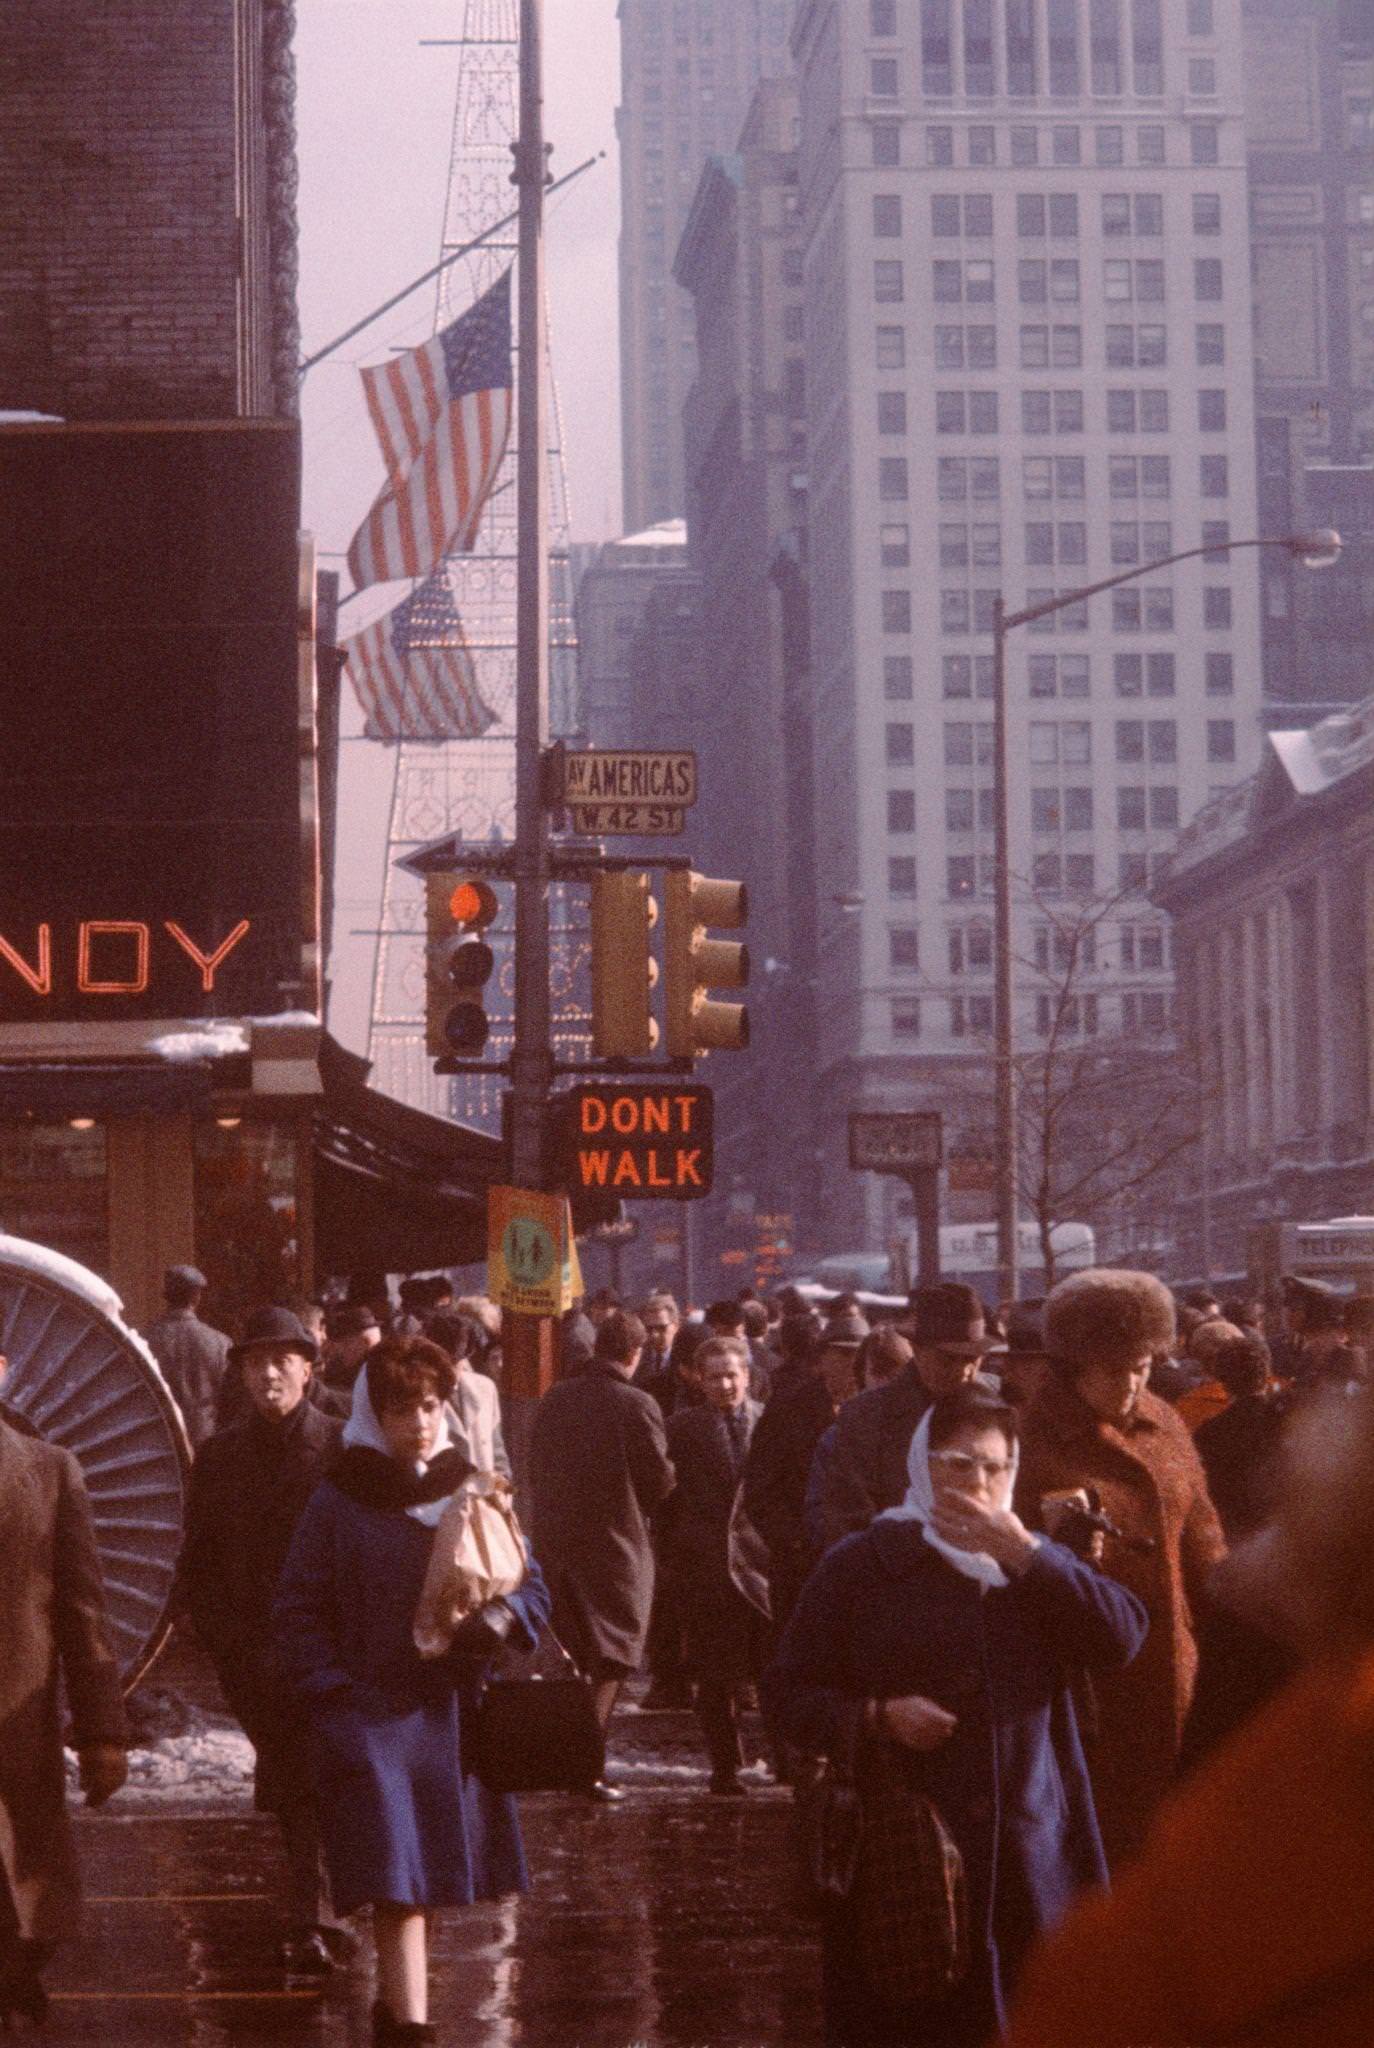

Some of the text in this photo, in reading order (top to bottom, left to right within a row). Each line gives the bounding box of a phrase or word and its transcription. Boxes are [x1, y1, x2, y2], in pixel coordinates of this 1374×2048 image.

[589, 759, 690, 796] AMERICAS
[608, 806, 640, 829] 42
[648, 806, 676, 829] ST
[580, 1096, 698, 1134] DONT
[578, 1149, 703, 1186] WALK
